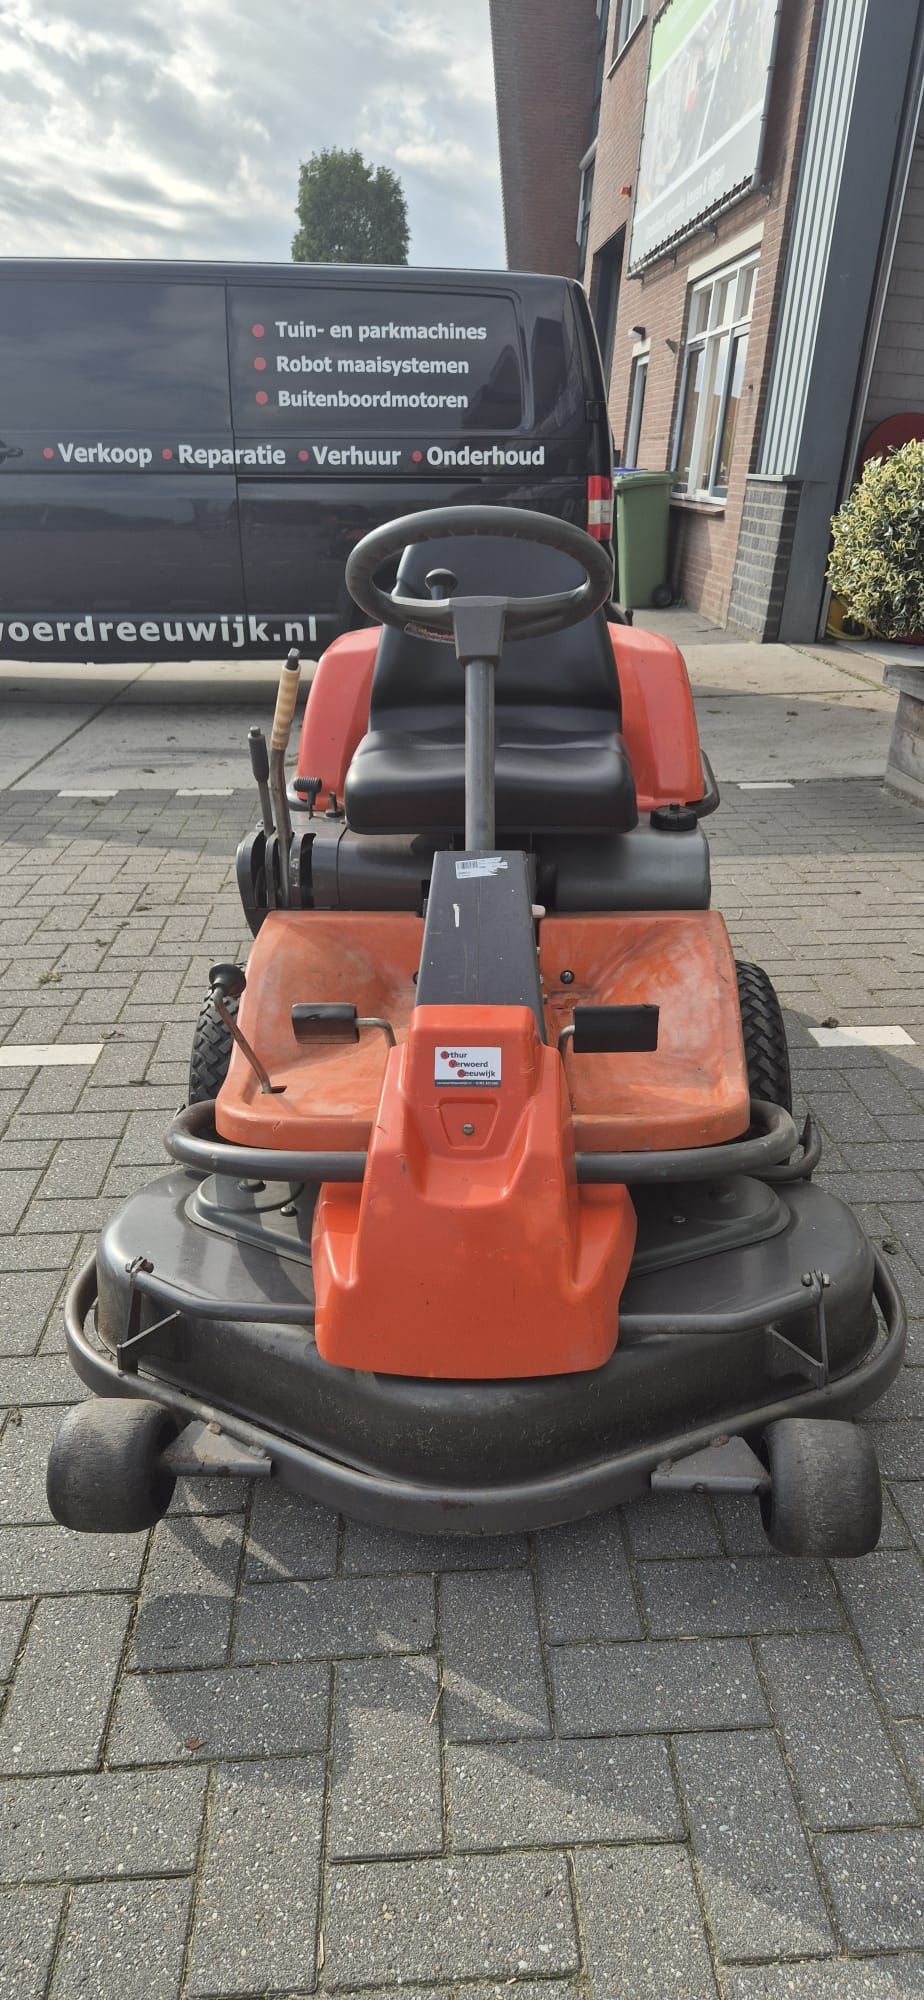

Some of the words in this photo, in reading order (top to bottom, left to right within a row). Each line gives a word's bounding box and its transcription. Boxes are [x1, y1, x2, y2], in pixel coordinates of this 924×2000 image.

[274, 320, 325, 339] Tuin-
[330, 324, 353, 339] en
[358, 321, 488, 343] parkmachines
[275, 354, 333, 374] Robot
[336, 355, 470, 377] maaisystemen
[277, 389, 469, 409] Buitenboordmotoren
[57, 442, 153, 468] Verkoop
[177, 443, 286, 468] Reparatie
[311, 445, 402, 466] Verhuur
[425, 445, 545, 466] Onderhoud
[0, 616, 317, 647] oerdreeuwijk.nl
